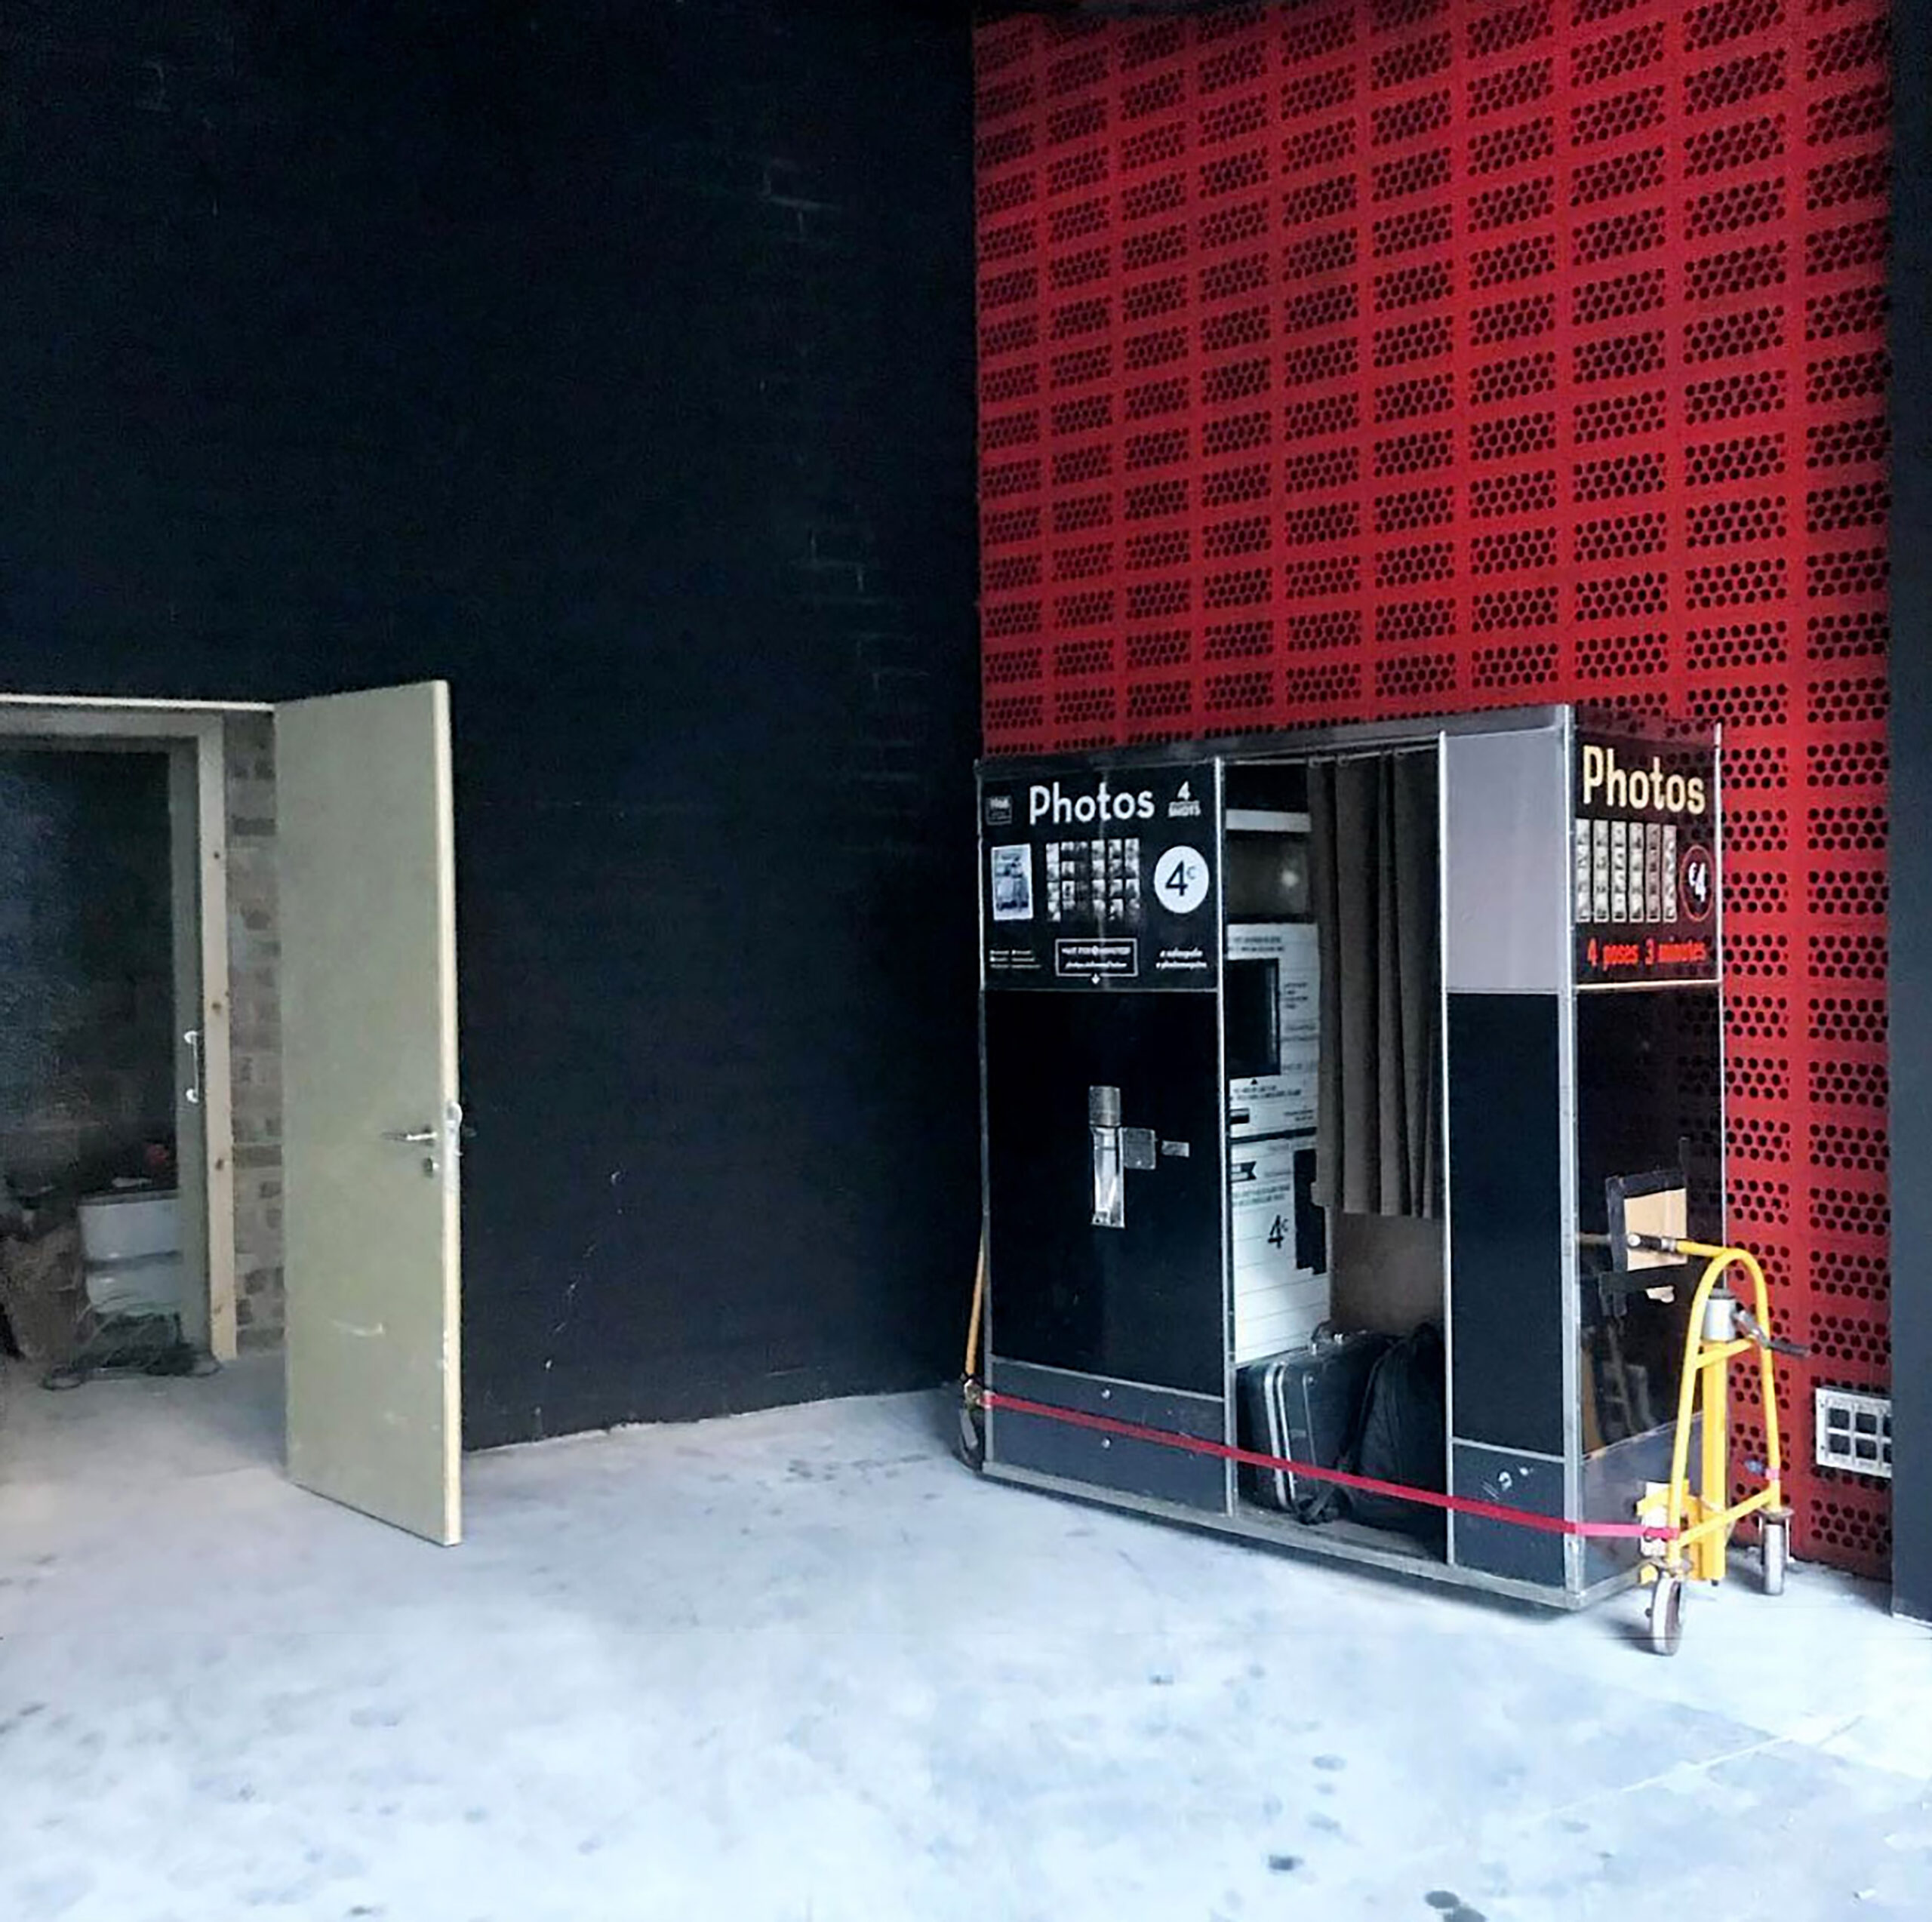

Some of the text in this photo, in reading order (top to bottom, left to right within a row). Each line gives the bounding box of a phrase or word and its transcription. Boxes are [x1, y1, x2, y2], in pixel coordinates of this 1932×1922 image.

[1177, 780, 1190, 801] 4
[1583, 745, 1706, 814] Photos
[1029, 781, 1155, 826] Photos
[1587, 937, 1598, 967] 4
[1644, 938, 1655, 965] 3
